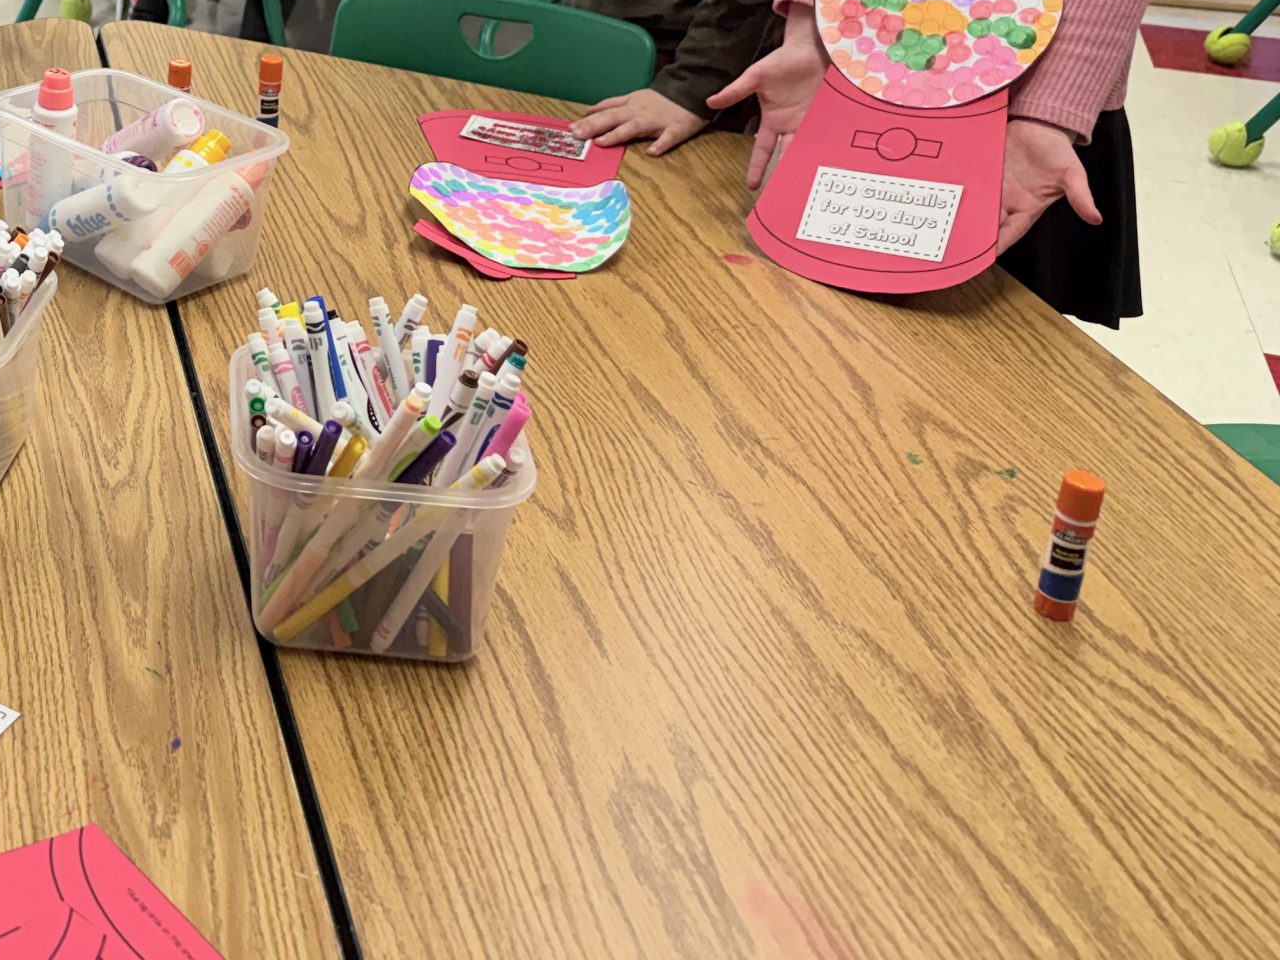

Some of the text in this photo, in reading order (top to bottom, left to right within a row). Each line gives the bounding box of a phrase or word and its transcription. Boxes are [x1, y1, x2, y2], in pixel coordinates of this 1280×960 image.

[822, 179, 948, 210] 100 Gumballs
[66, 212, 111, 237] blue
[820, 198, 938, 230] for 100 days
[829, 222, 918, 248] of School
